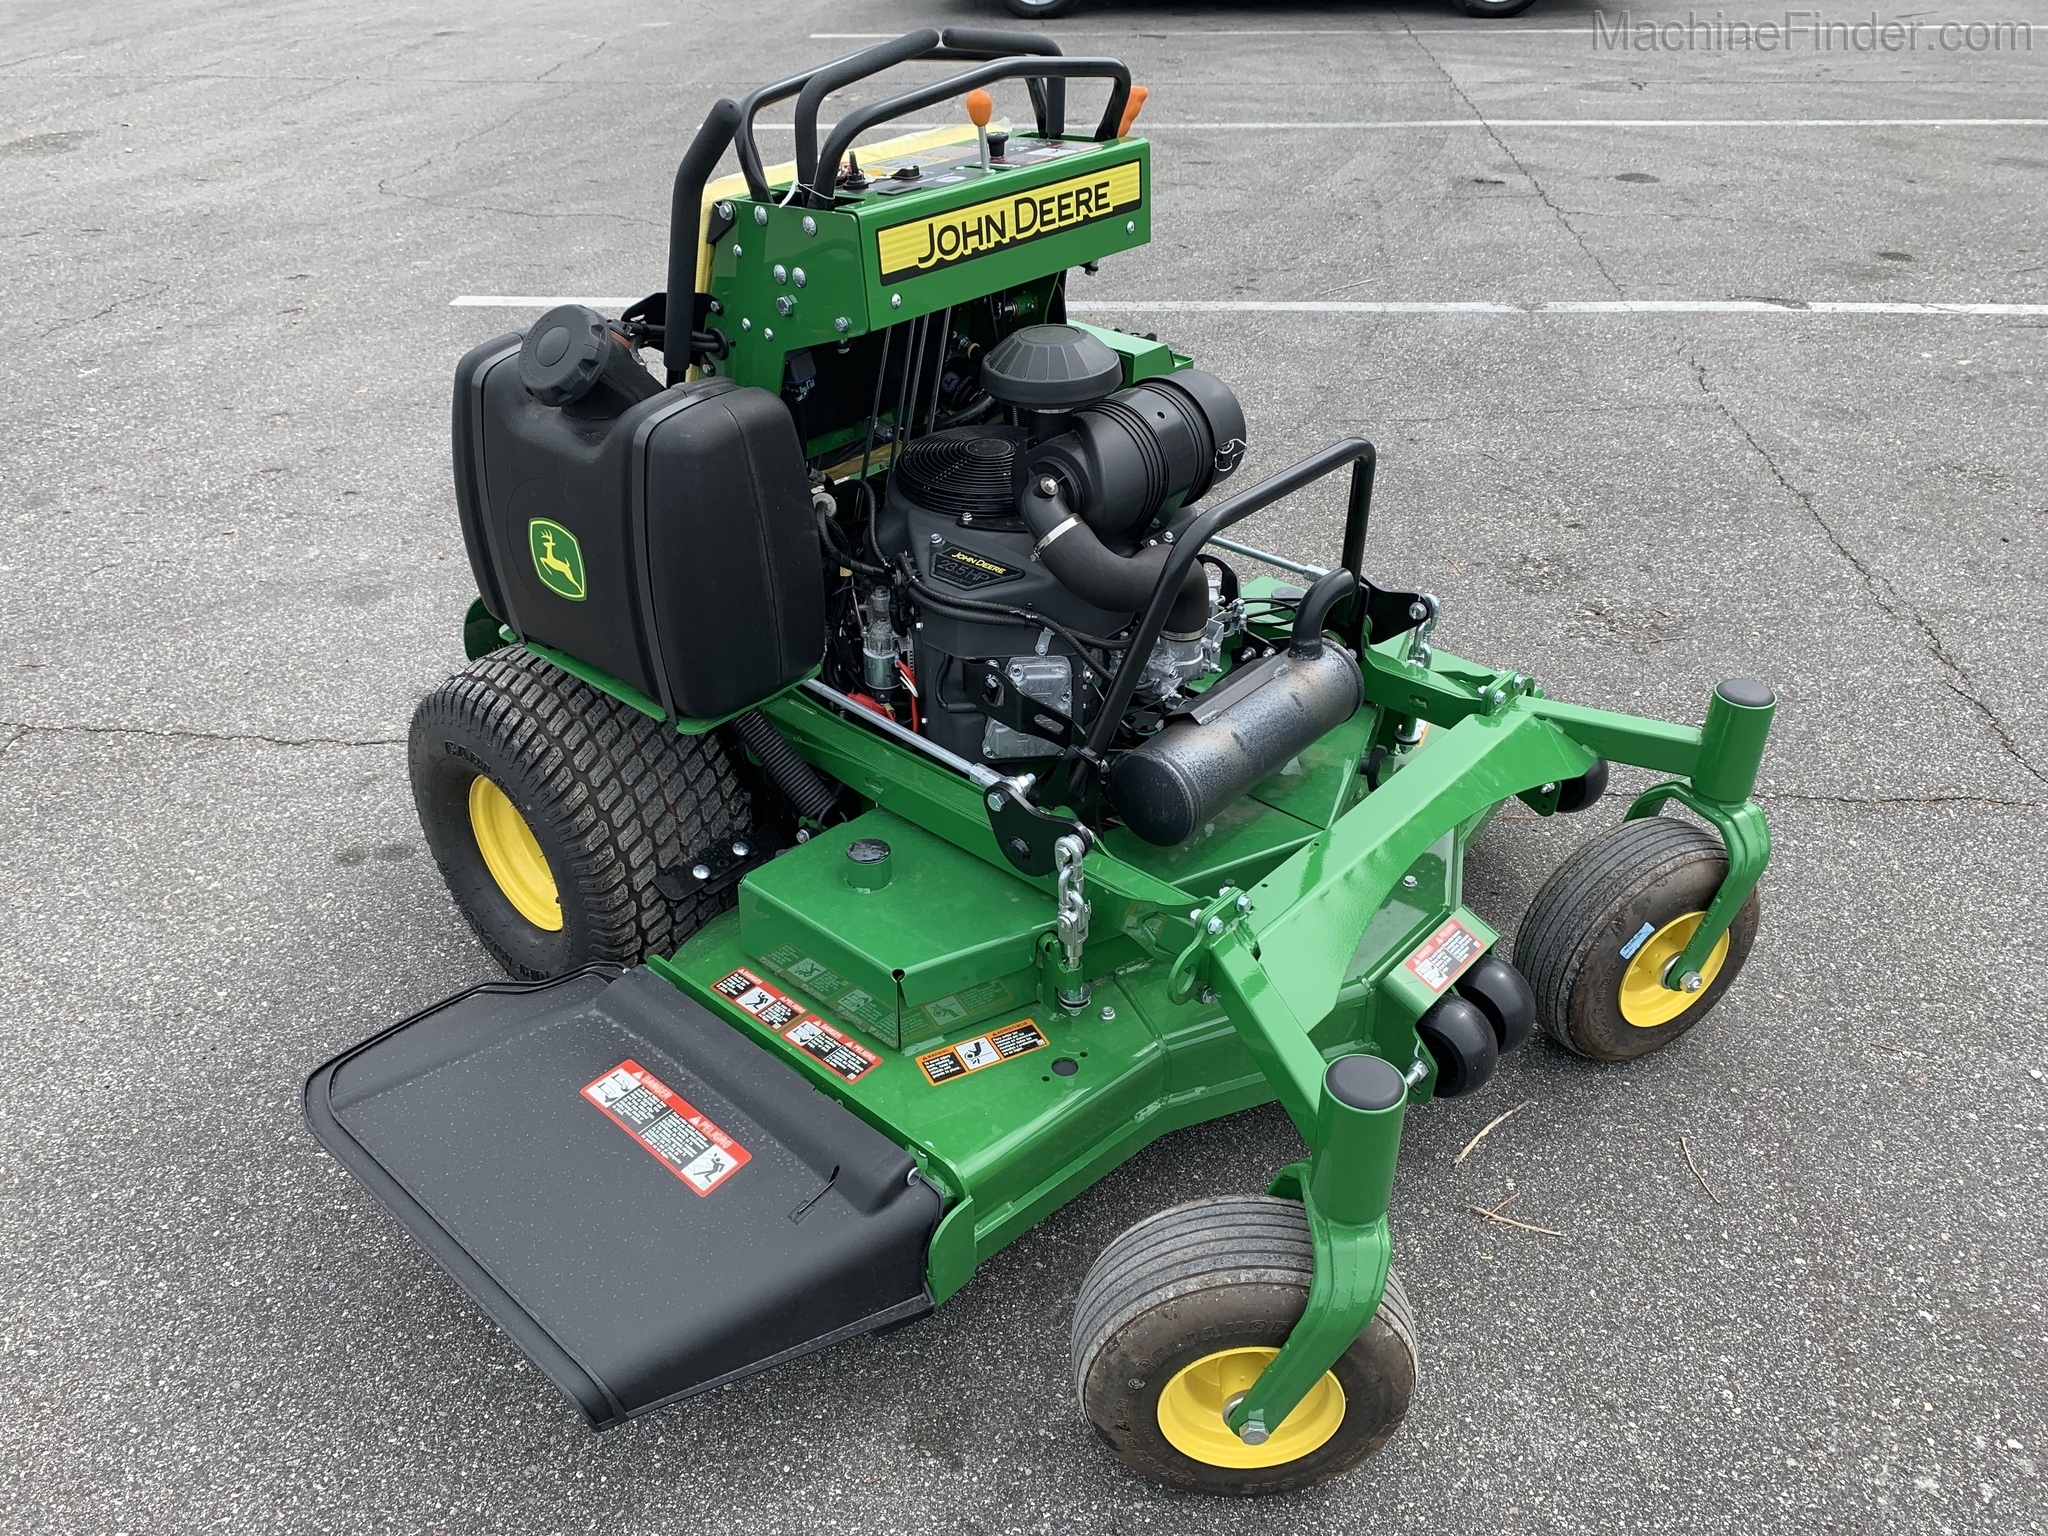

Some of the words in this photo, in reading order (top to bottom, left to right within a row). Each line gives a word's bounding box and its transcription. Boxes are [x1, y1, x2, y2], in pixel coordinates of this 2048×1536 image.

[917, 210, 1006, 265] JOHN
[1013, 181, 1111, 235] DEERE
[936, 560, 969, 575] 23.5
[965, 569, 990, 581] HP
[951, 552, 978, 564] JOHN
[975, 560, 1007, 574] DEERE
[743, 969, 763, 985] DANGER
[784, 997, 807, 1014] PELIGRO
[820, 1022, 843, 1039] DANGER
[996, 1021, 1029, 1035] ADVERTENCIA
[851, 1042, 877, 1061] PELIGRO
[927, 1049, 950, 1059] WARNING
[641, 1075, 673, 1100] DANGER
[700, 1121, 733, 1150] PELIGRO
[1136, 1319, 1291, 1376] RELIANCE
